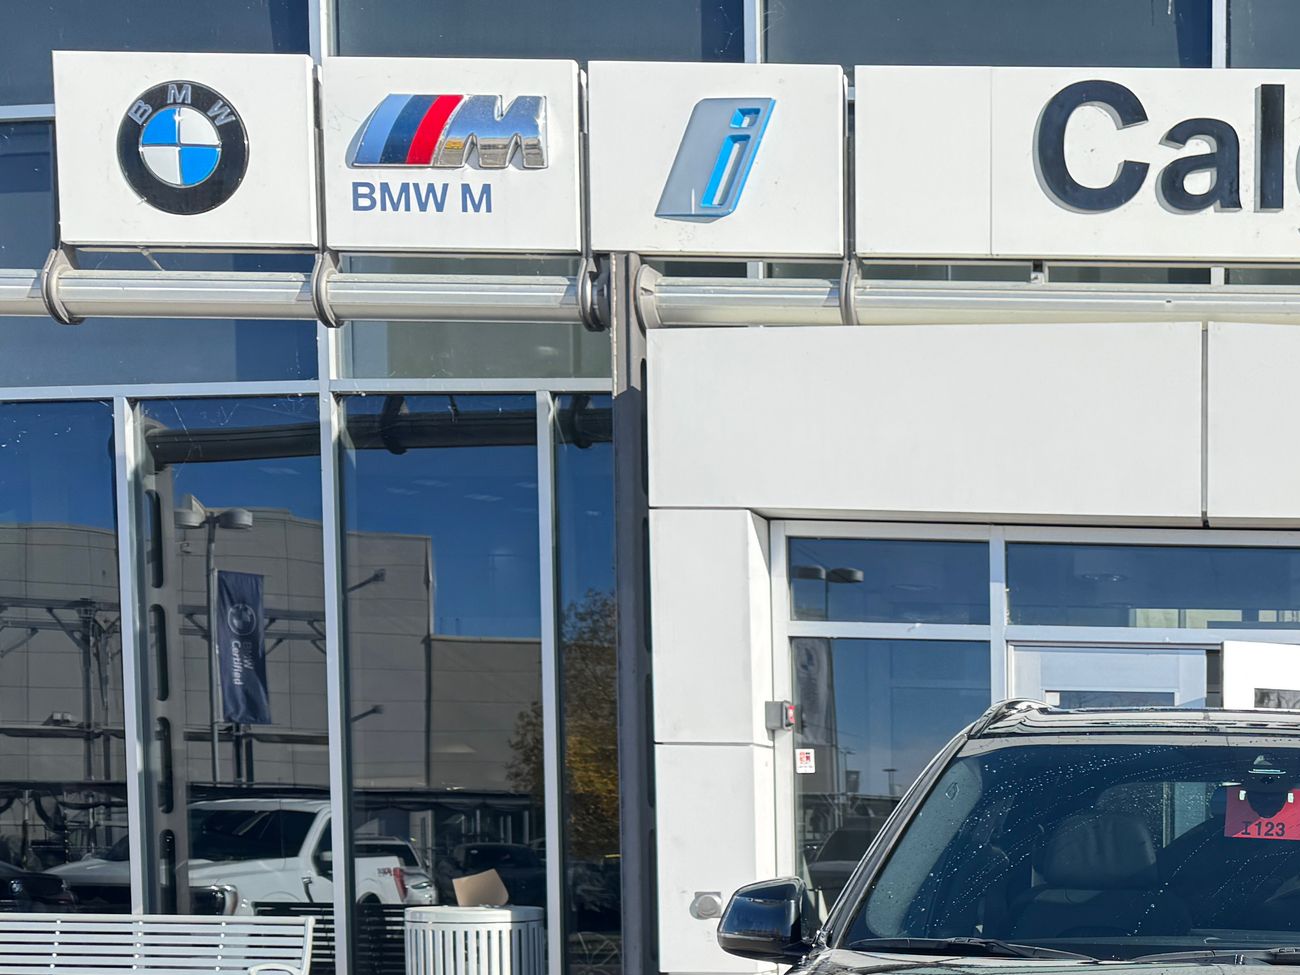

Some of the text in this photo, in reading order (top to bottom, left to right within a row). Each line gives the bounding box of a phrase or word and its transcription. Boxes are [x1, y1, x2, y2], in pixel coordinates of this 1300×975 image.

[127, 83, 236, 127] BMW
[430, 94, 549, 169] M
[700, 106, 762, 208] i
[351, 181, 493, 214] BMW M
[231, 640, 244, 685] Certified
